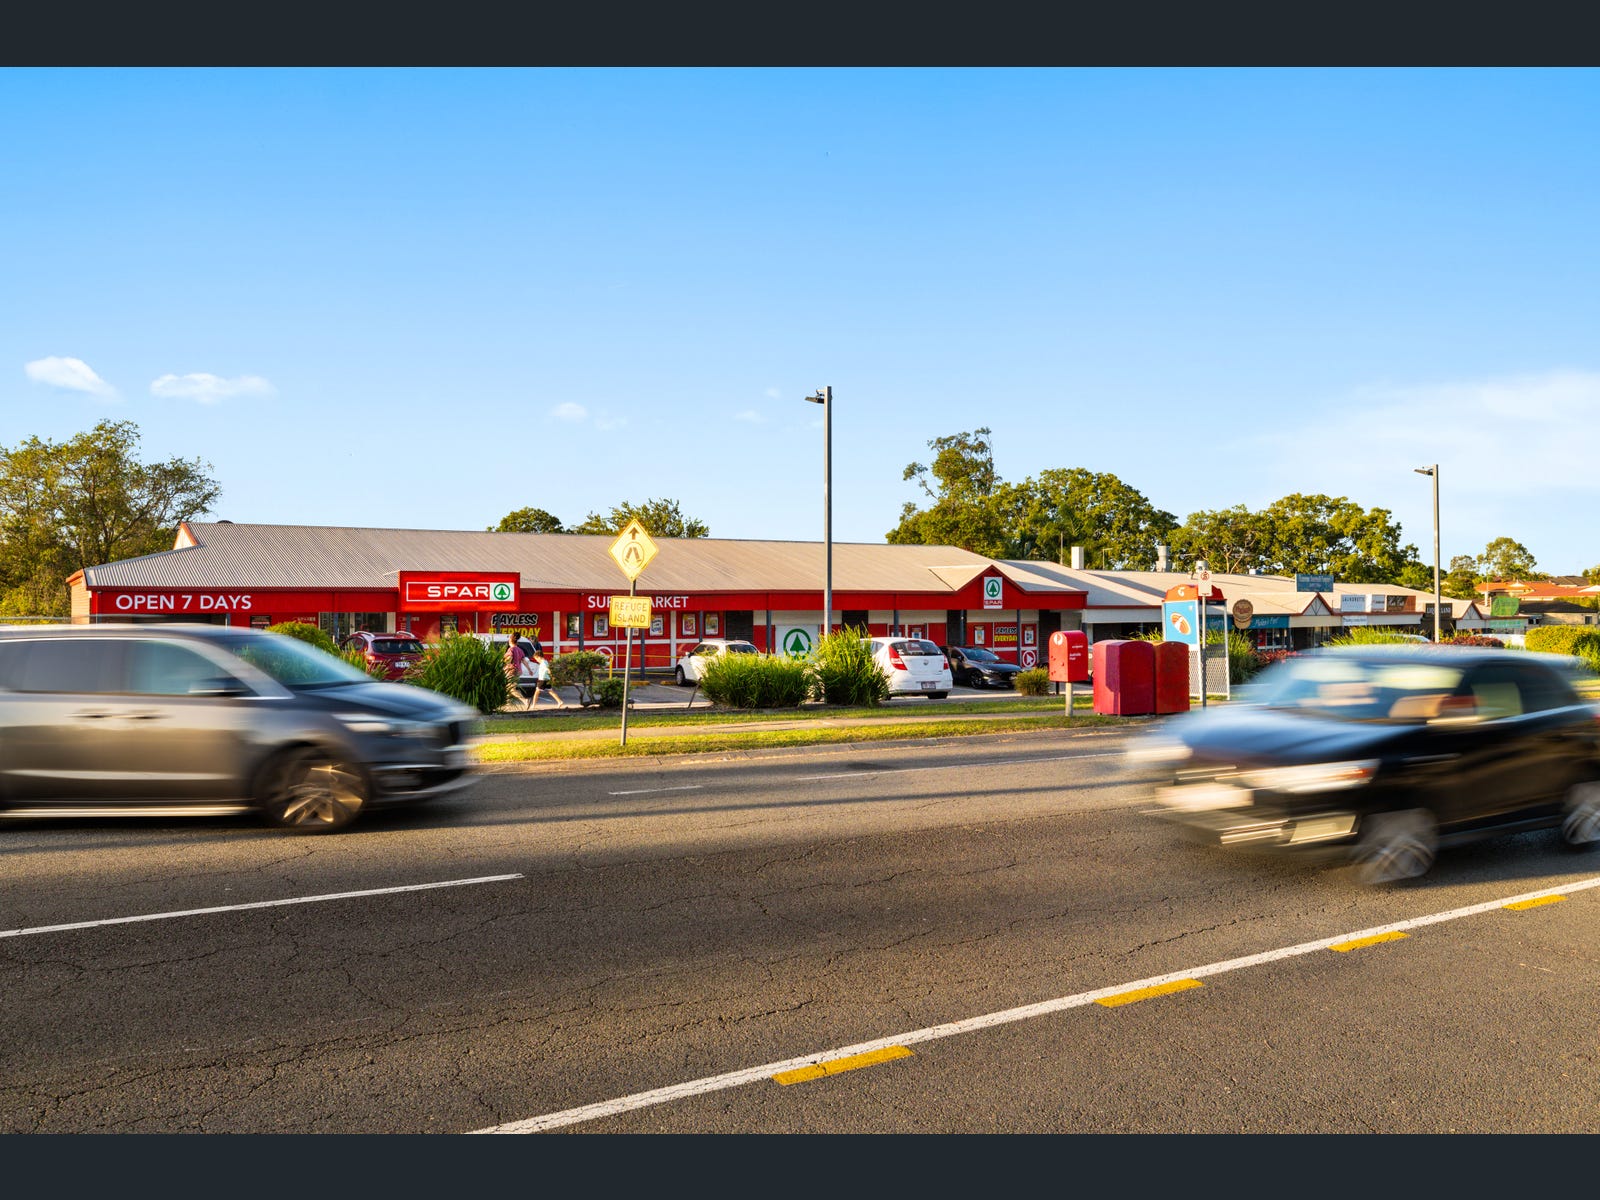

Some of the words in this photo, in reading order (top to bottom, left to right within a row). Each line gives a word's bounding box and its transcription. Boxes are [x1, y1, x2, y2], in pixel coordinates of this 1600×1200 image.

[426, 586, 489, 597] SPAR
[115, 594, 175, 610] OPEN
[181, 595, 193, 610] 7
[199, 595, 252, 610] DAYS
[614, 601, 648, 612] REFUGE
[614, 613, 646, 624] ISLAND
